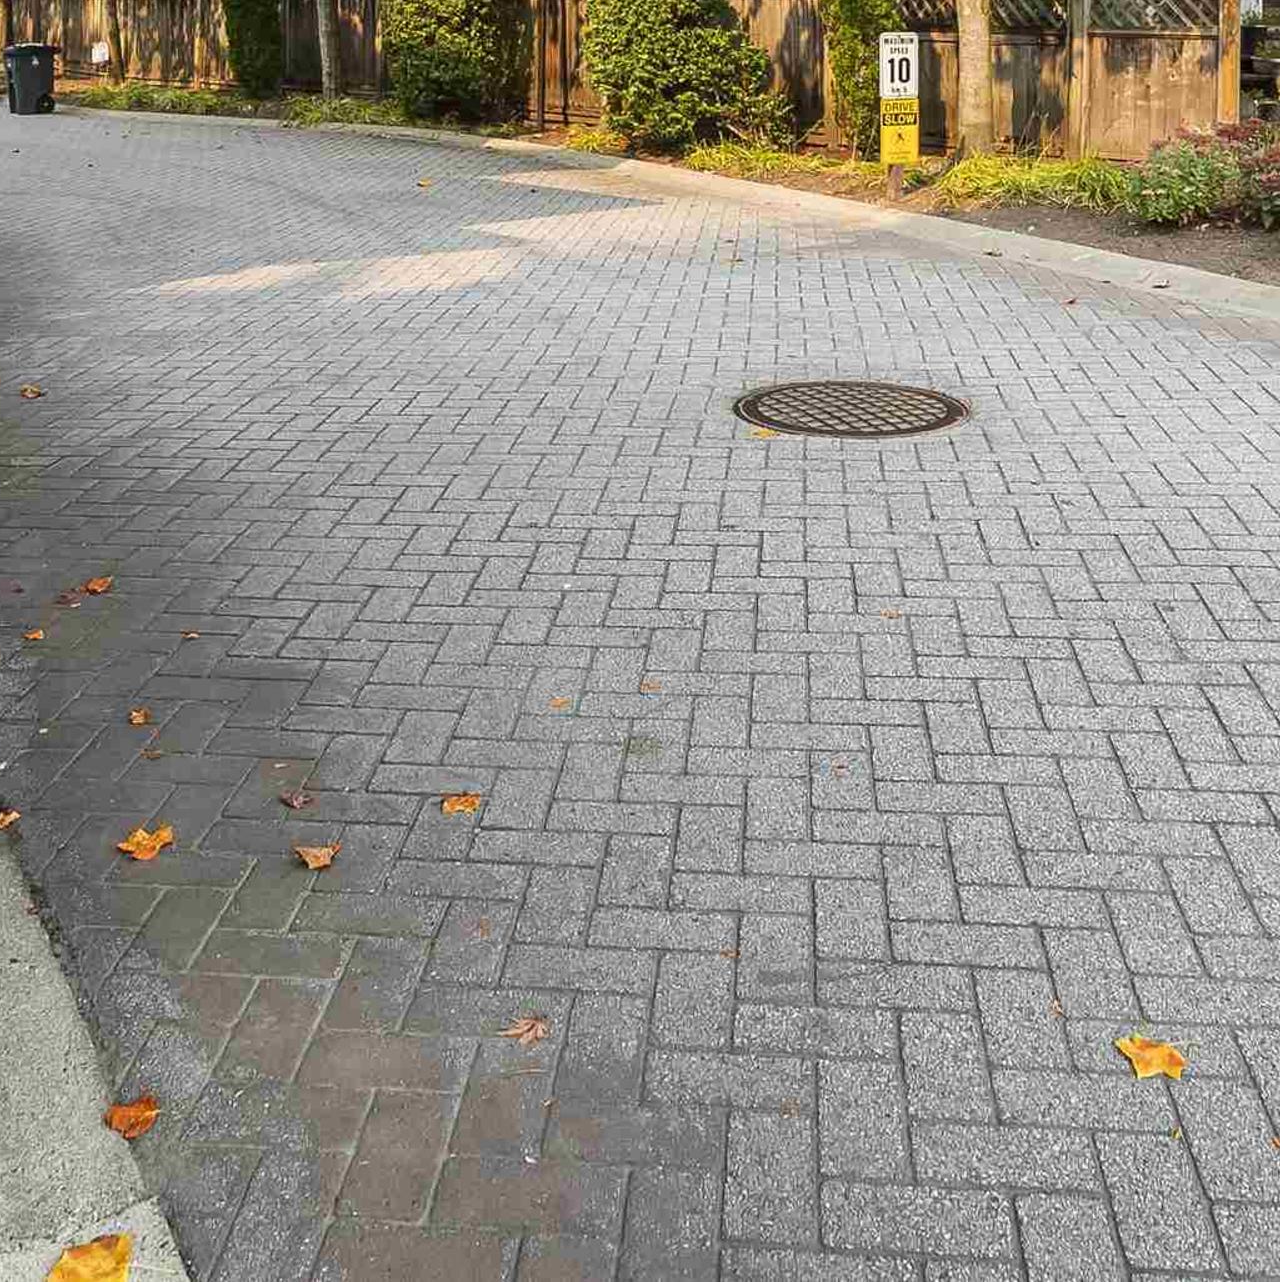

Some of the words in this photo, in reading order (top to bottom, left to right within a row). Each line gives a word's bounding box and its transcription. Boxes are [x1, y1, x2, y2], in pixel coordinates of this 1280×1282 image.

[888, 57, 910, 83] 10
[884, 102, 915, 112] DRIVE
[884, 113, 916, 124] SLOW
